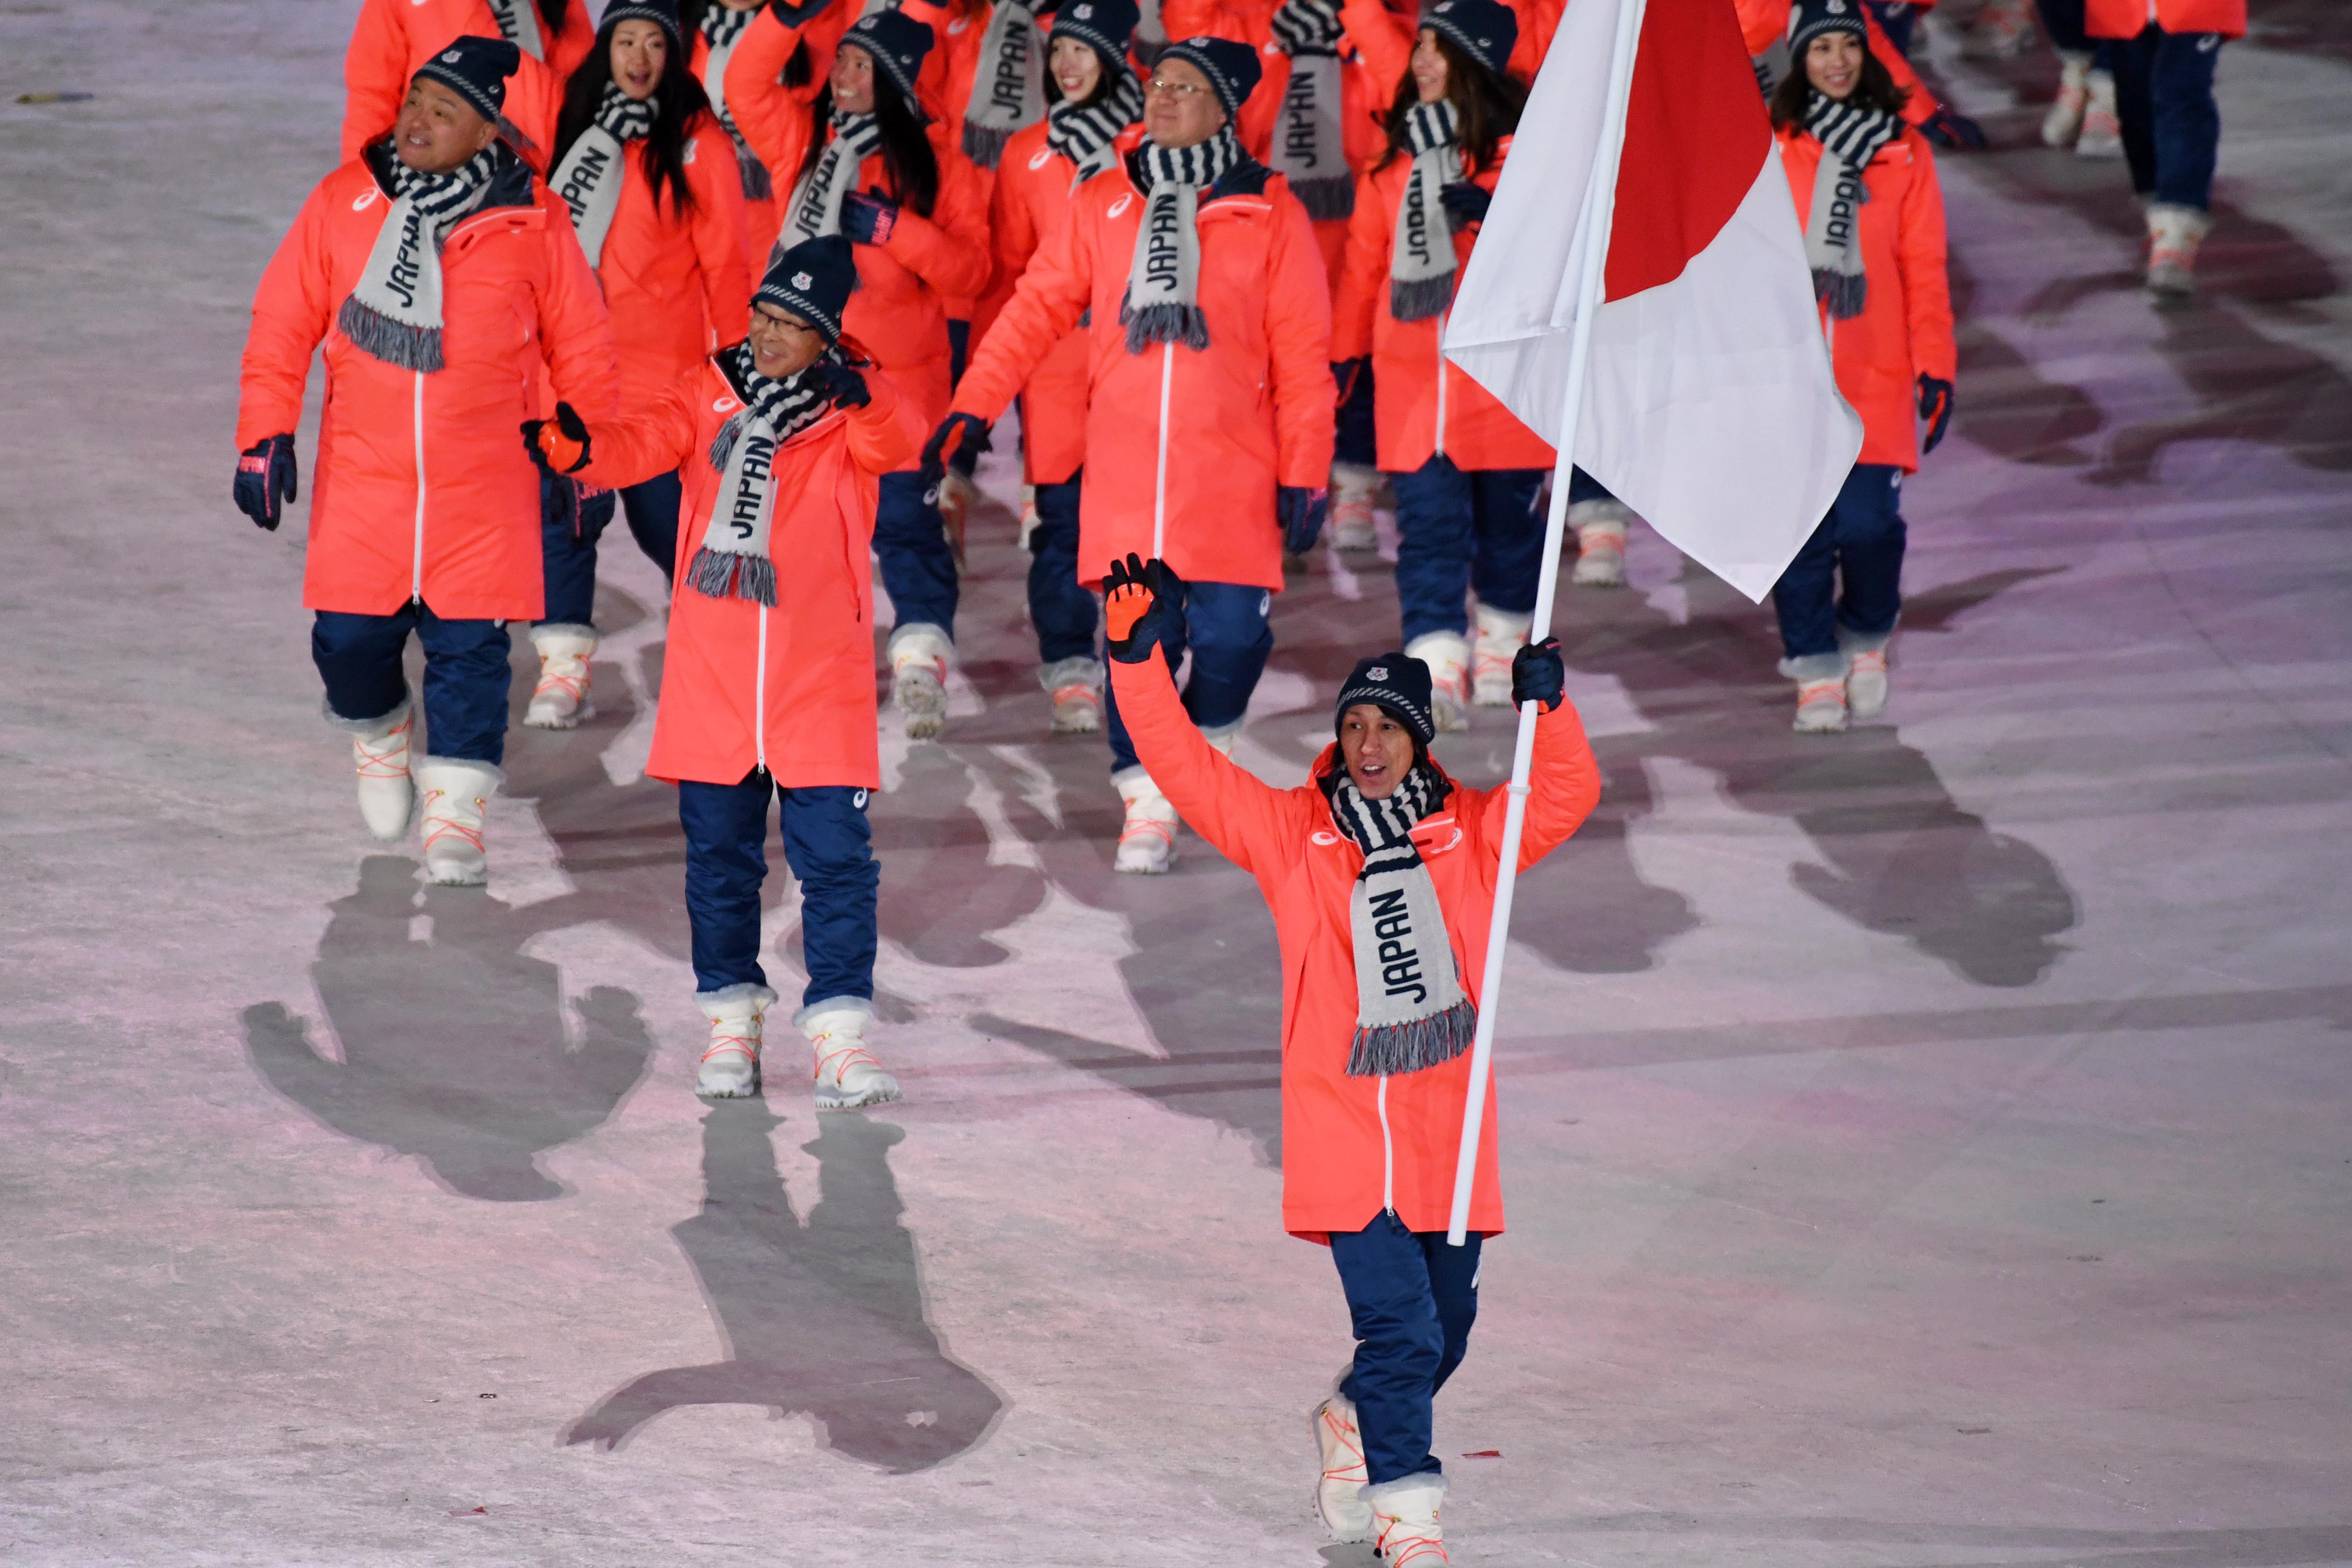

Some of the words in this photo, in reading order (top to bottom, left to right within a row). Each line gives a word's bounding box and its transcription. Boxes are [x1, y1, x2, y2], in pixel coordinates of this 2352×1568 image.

[991, 21, 1029, 119] JAPAN
[1285, 72, 1317, 168] JAPAN
[385, 204, 423, 308] JAPAN
[1146, 194, 1178, 291] JAPAN
[730, 436, 775, 539] JAPAN
[1368, 888, 1427, 1004] JAPAN
